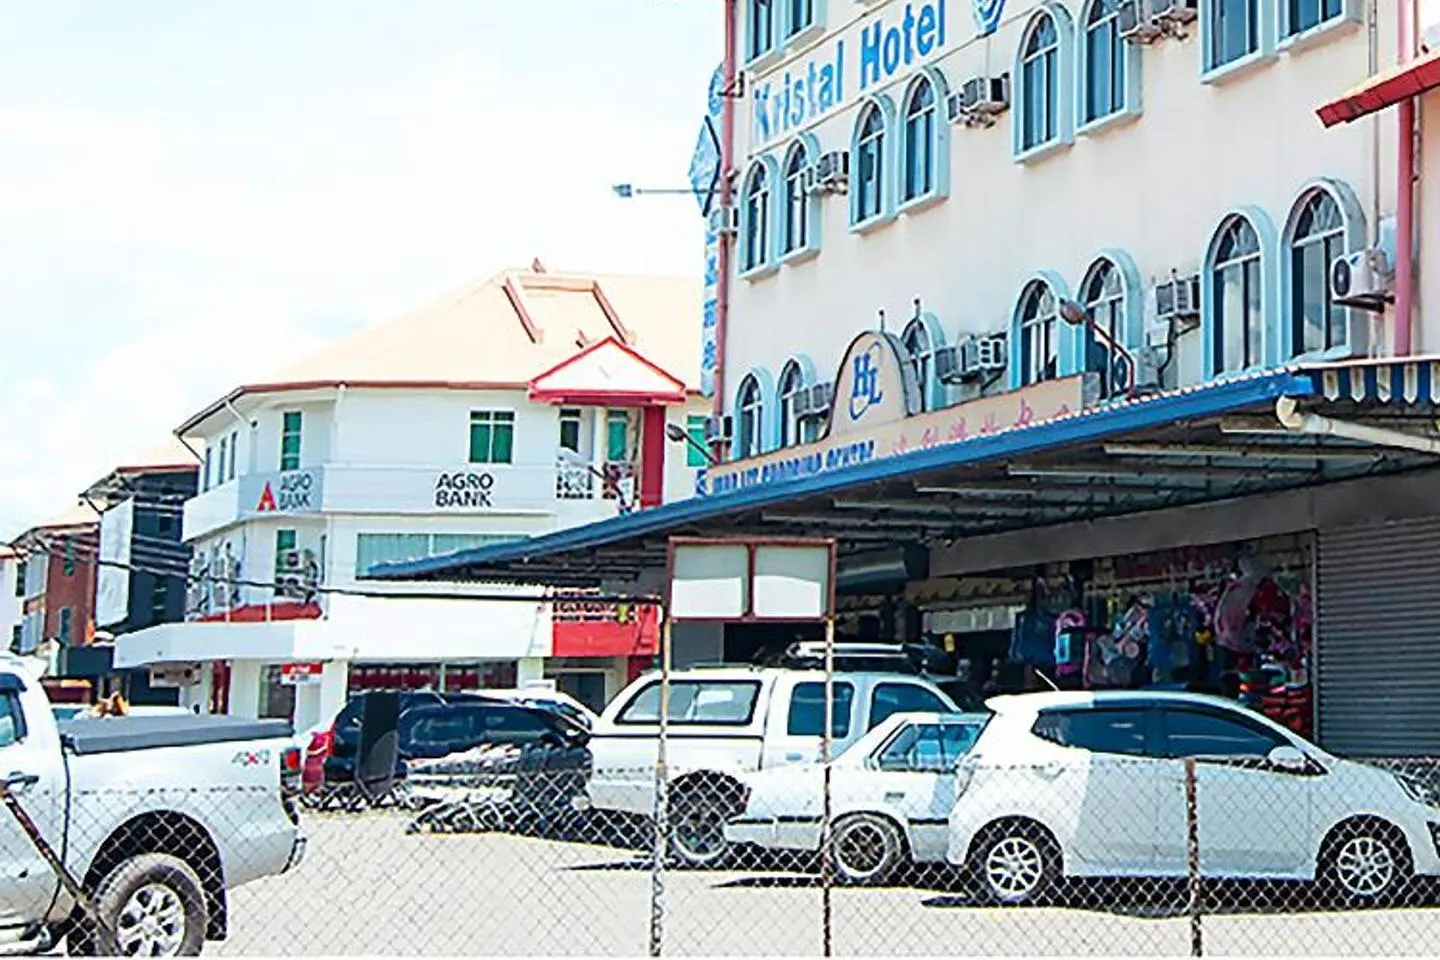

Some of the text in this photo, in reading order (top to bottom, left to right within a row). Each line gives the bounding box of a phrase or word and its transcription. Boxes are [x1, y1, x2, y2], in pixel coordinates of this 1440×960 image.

[754, 40, 844, 143] Kristal
[436, 473, 494, 490] AGRO
[435, 490, 492, 507] BANK
